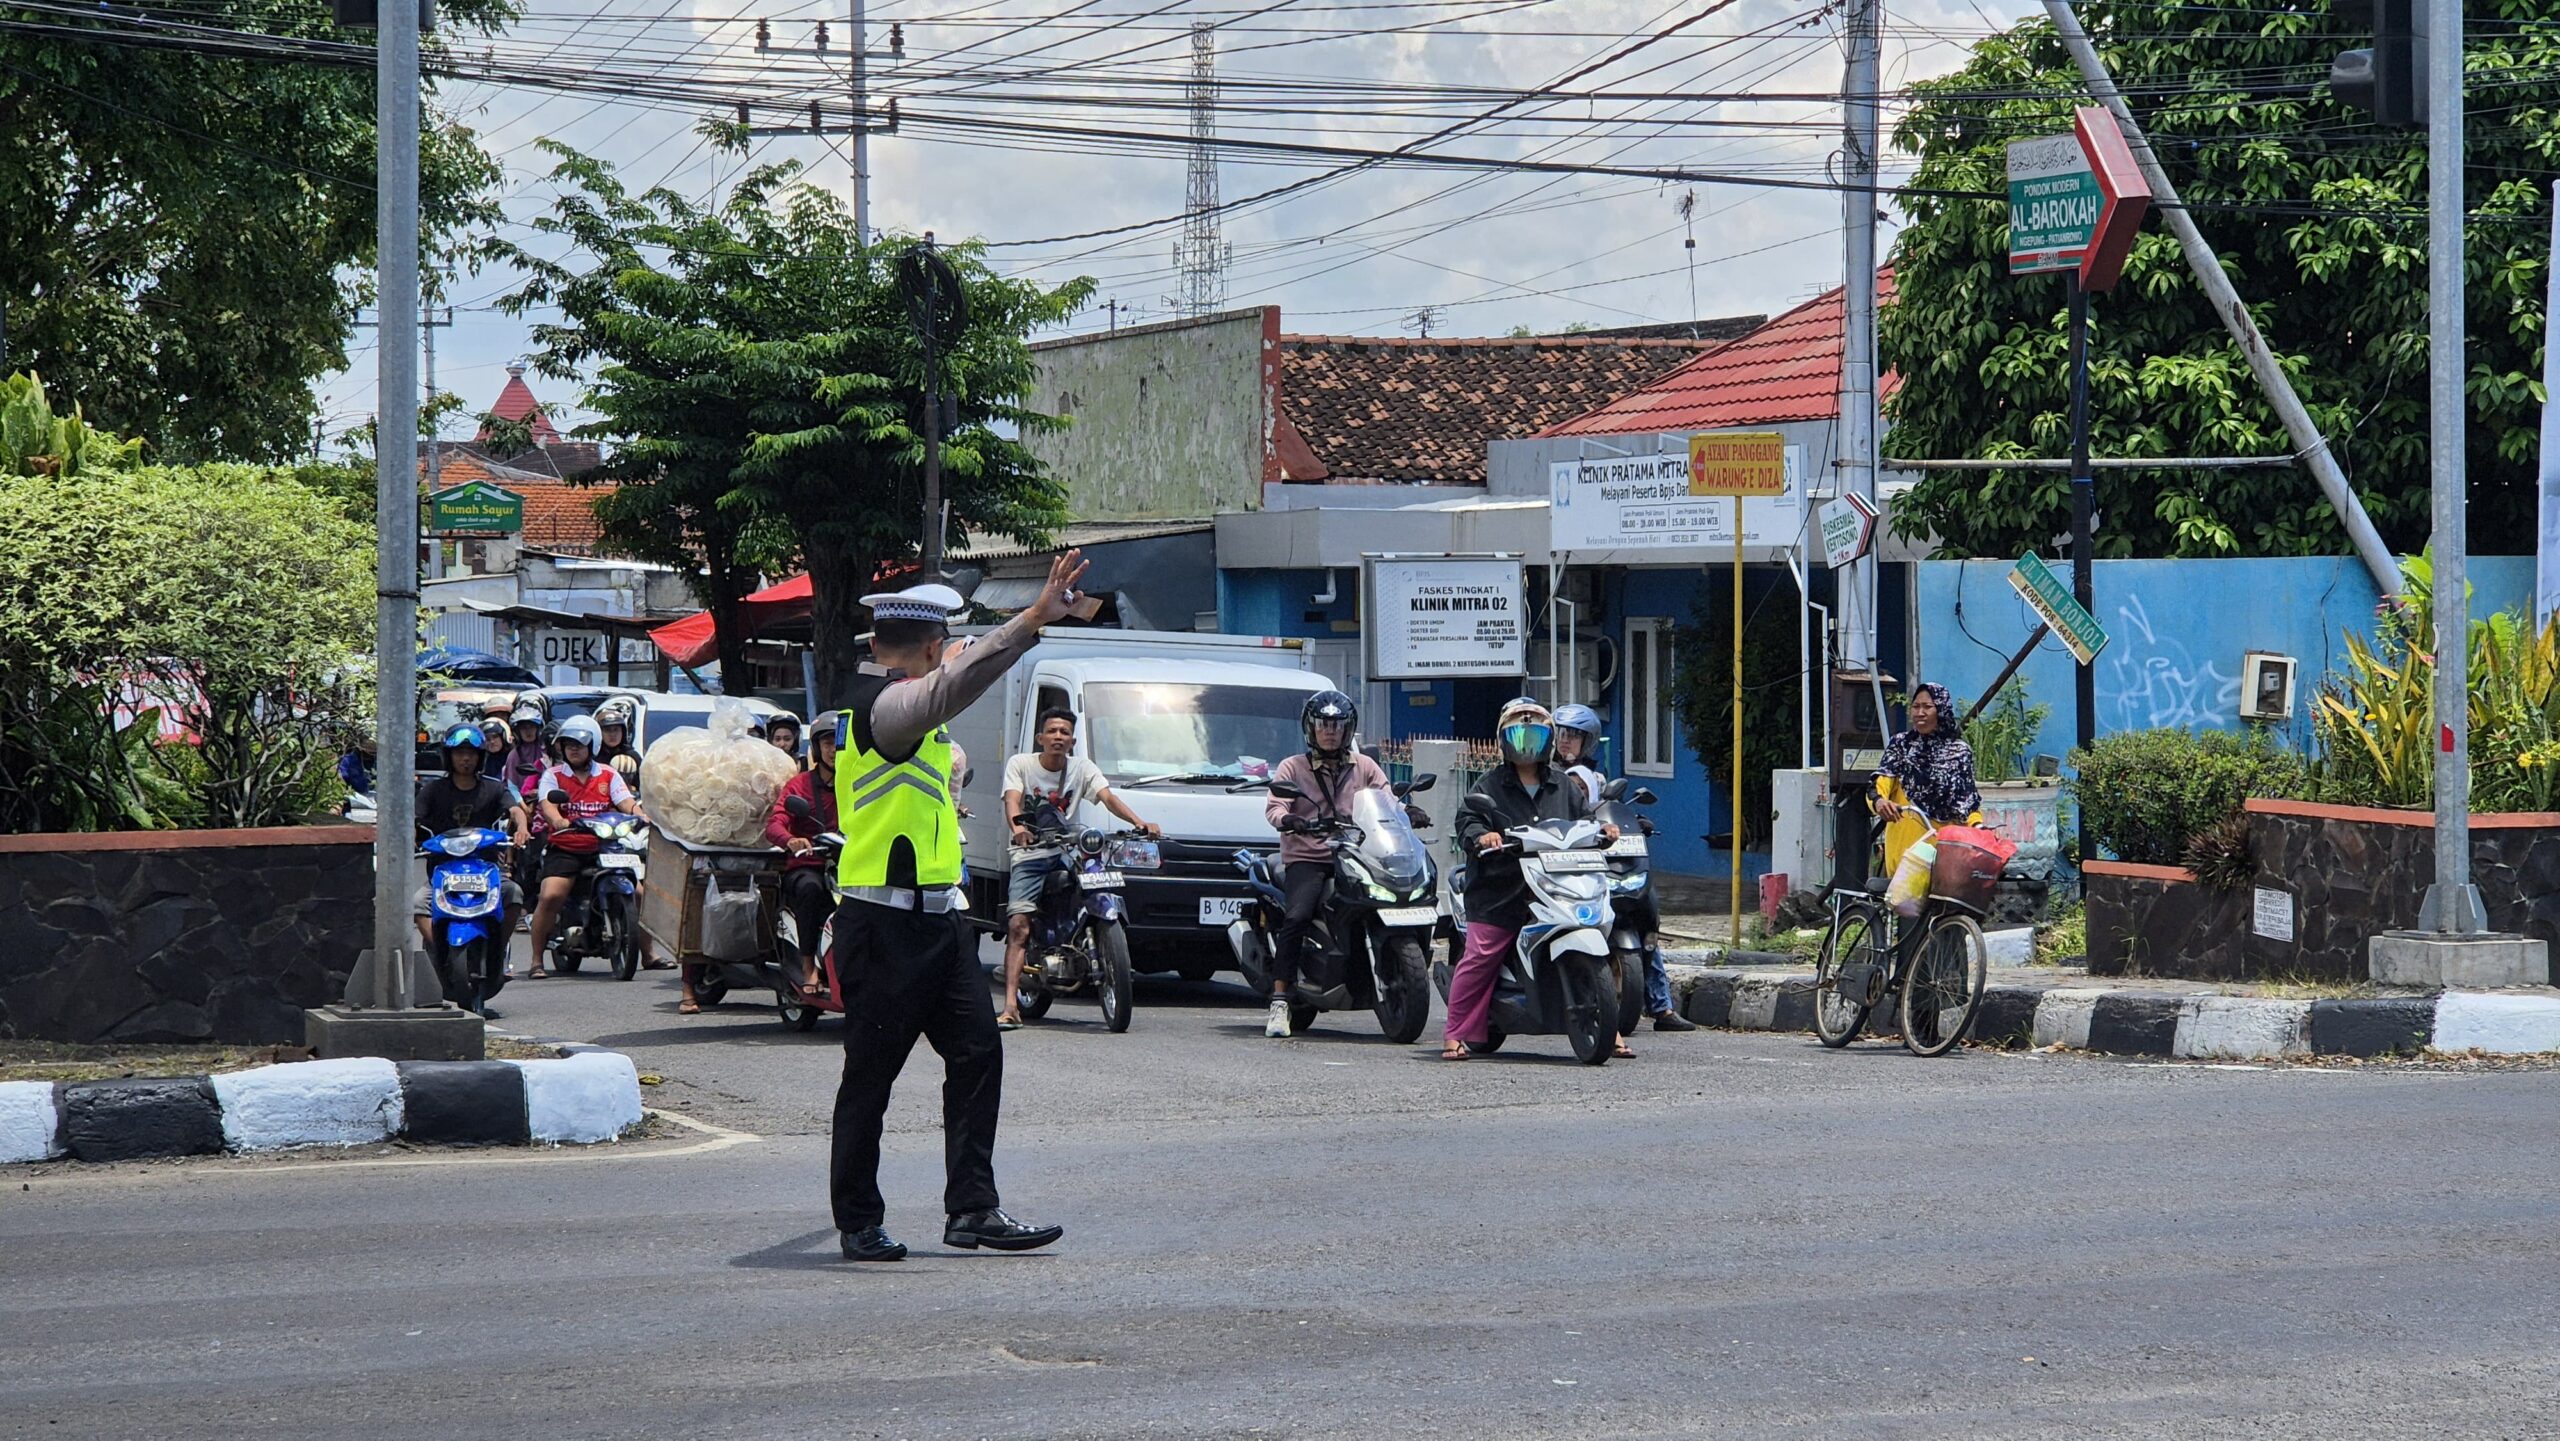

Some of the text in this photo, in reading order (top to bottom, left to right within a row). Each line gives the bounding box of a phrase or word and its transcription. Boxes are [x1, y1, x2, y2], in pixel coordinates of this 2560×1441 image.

[2024, 179, 2079, 198] PONDOK MODERN
[2011, 195, 2097, 232] AL-BAROKAH
[1707, 443, 1780, 461] AYAM PANGGANG
[1577, 465, 1609, 484] KLINIK
[1611, 463, 1655, 482] PRATAMA
[1658, 460, 1689, 480] MITRA
[1758, 467, 1780, 488] DIZA
[1601, 484, 1631, 503] Melayani
[1632, 484, 1657, 499] Peserta
[1660, 482, 1675, 501] Bpjs
[441, 504, 515, 517] Rumah Sayur
[1823, 510, 1855, 536] PUSKESMAS
[1418, 586, 1454, 595] FASKES
[1456, 586, 1494, 595] TINGKAT
[1411, 597, 1508, 611] KLINIK MITRA 02
[2033, 572, 2064, 606] IMAM
[2060, 601, 2100, 648] BONJOL
[2021, 584, 2043, 608] KODE
[2041, 605, 2057, 622] POS
[2057, 624, 2079, 649] 64314
[544, 637, 598, 664] OJEK
[1204, 900, 1212, 914] B
